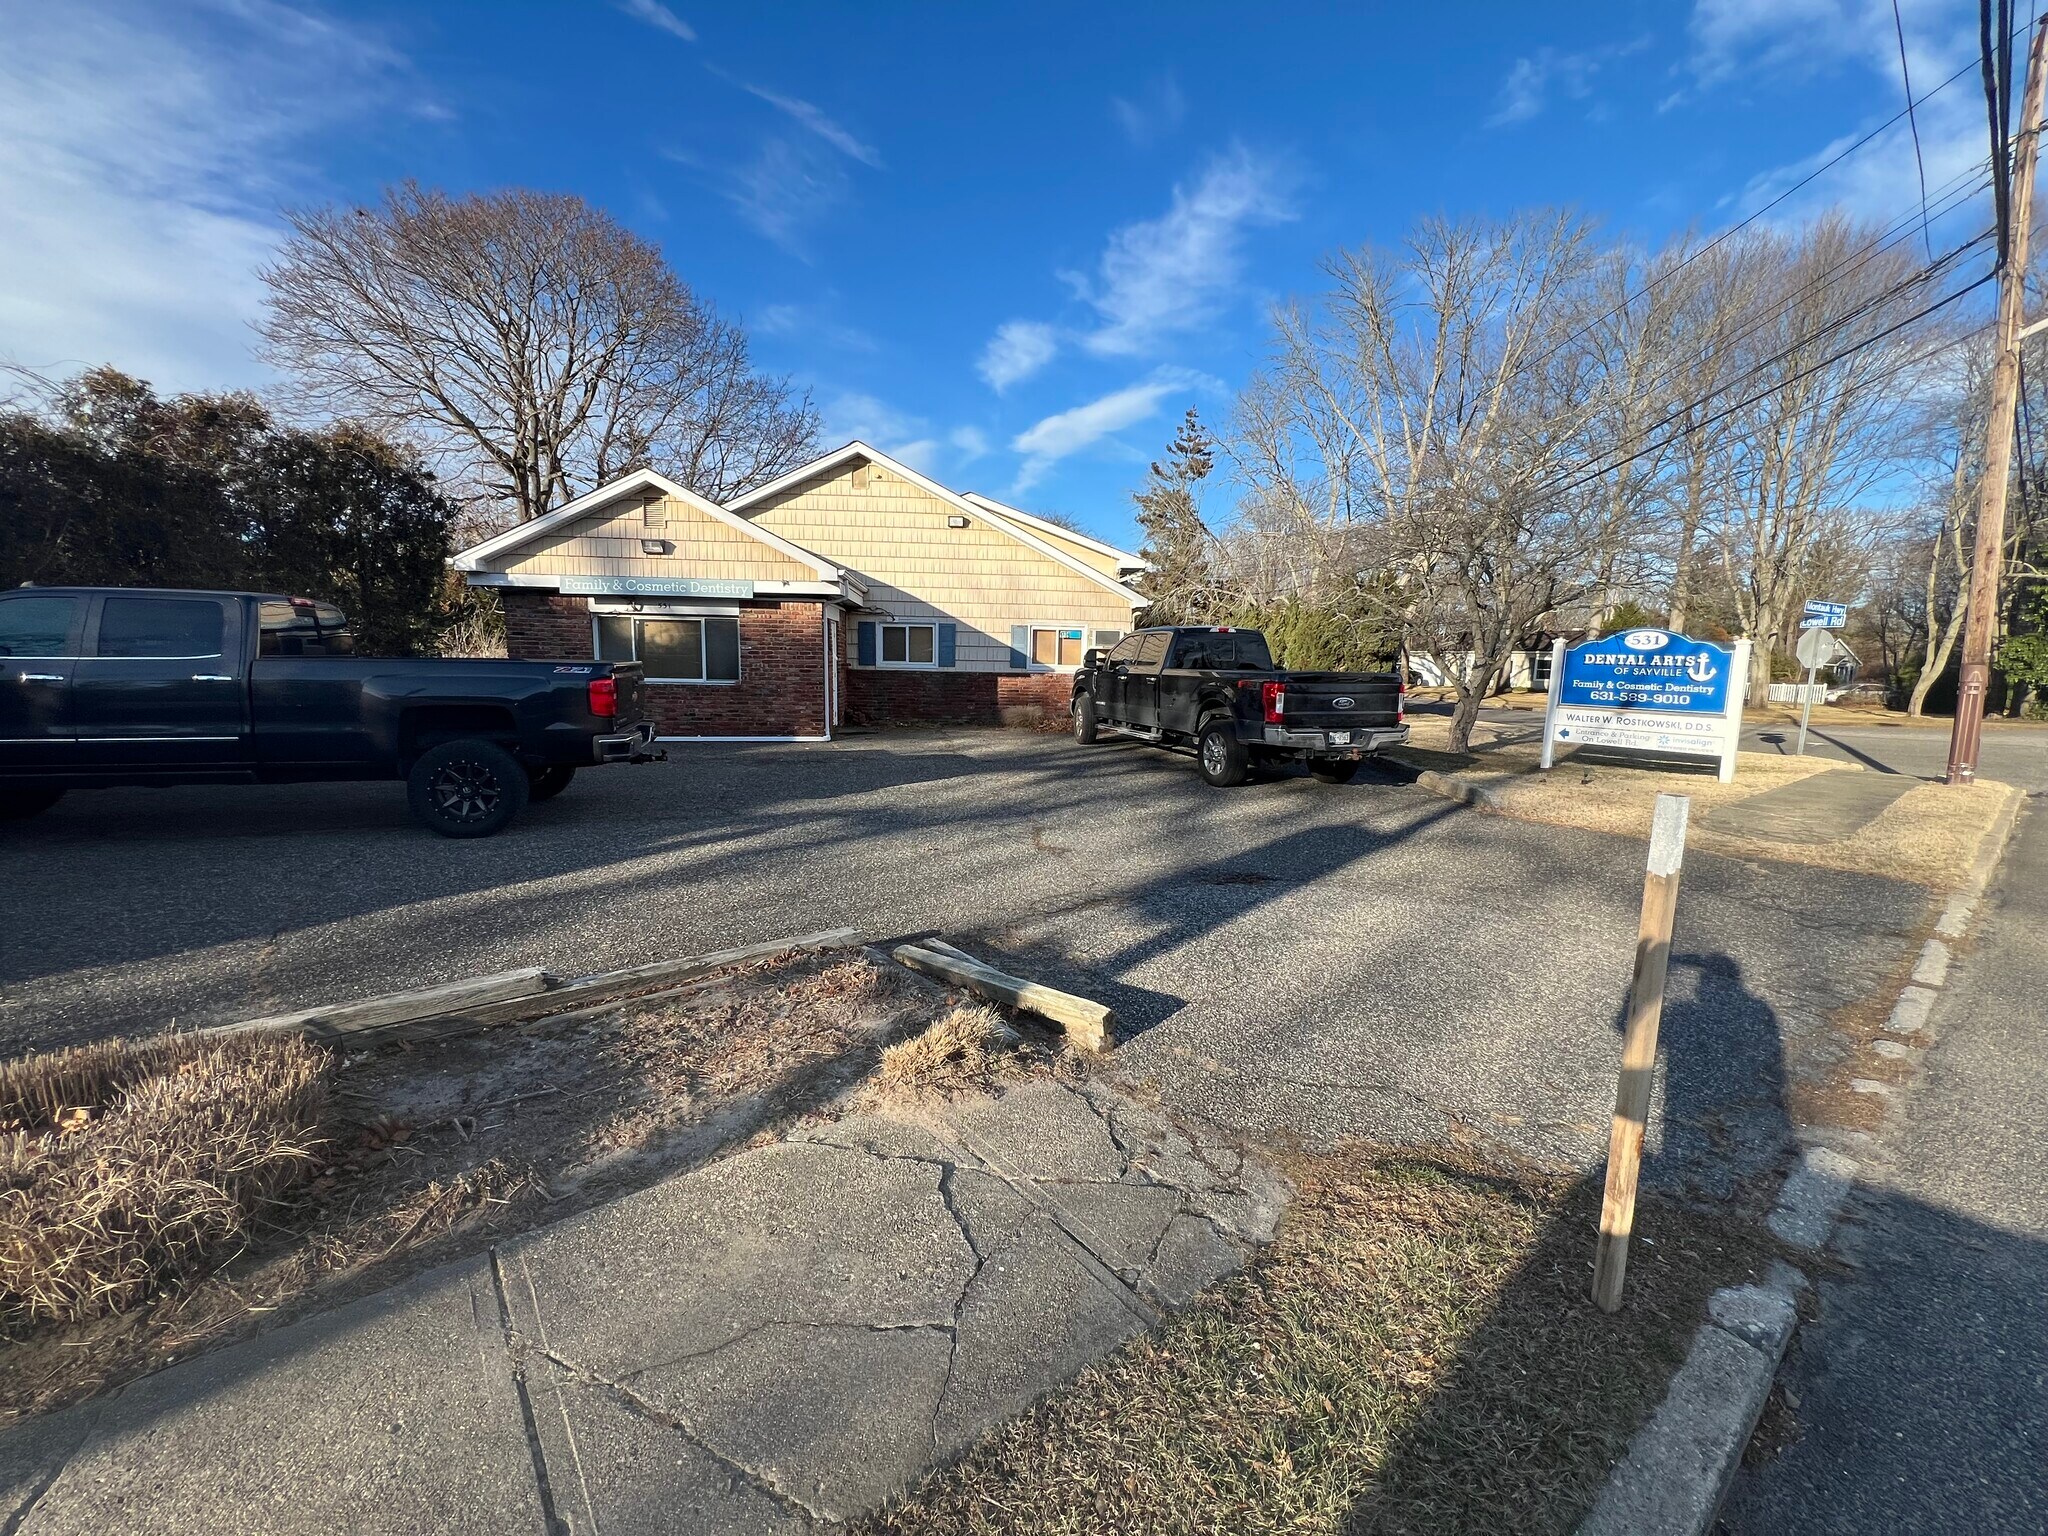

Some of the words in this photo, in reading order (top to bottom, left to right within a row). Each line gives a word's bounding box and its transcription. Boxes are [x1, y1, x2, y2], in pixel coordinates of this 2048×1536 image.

[564, 578, 609, 592] Family
[613, 579, 623, 591] &
[626, 579, 687, 592] Cosmetic
[690, 581, 749, 597] Dentistry
[1807, 601, 1830, 611] Montauk
[1831, 604, 1845, 615] Hwy
[1802, 616, 1828, 626] Lowell
[1830, 617, 1843, 625] Rd
[1631, 635, 1661, 645] 531
[1584, 654, 1646, 666] DENTAL
[1650, 656, 1696, 667] ARTS
[553, 666, 592, 674] Z71
[1613, 667, 1629, 675] OF
[1633, 668, 1682, 677] SAYVILLE
[1573, 680, 1604, 690] Family
[1606, 681, 1614, 689] &
[1616, 681, 1663, 691] Cosmetic
[1665, 683, 1715, 696] Dentistry
[1590, 691, 1690, 705] 631-589-9010
[1566, 714, 1601, 724] WALTER
[1602, 715, 1614, 725] W.
[1616, 716, 1682, 730] ROSTKOWSKI,
[1685, 722, 1714, 732] D.D.S.
[1575, 728, 1609, 737] Entrance
[1619, 732, 1650, 742] Parking
[1581, 735, 1594, 743] On
[1596, 737, 1622, 746] Lowell
[1625, 739, 1639, 747] Rd.
[1673, 737, 1712, 747] invisalign
